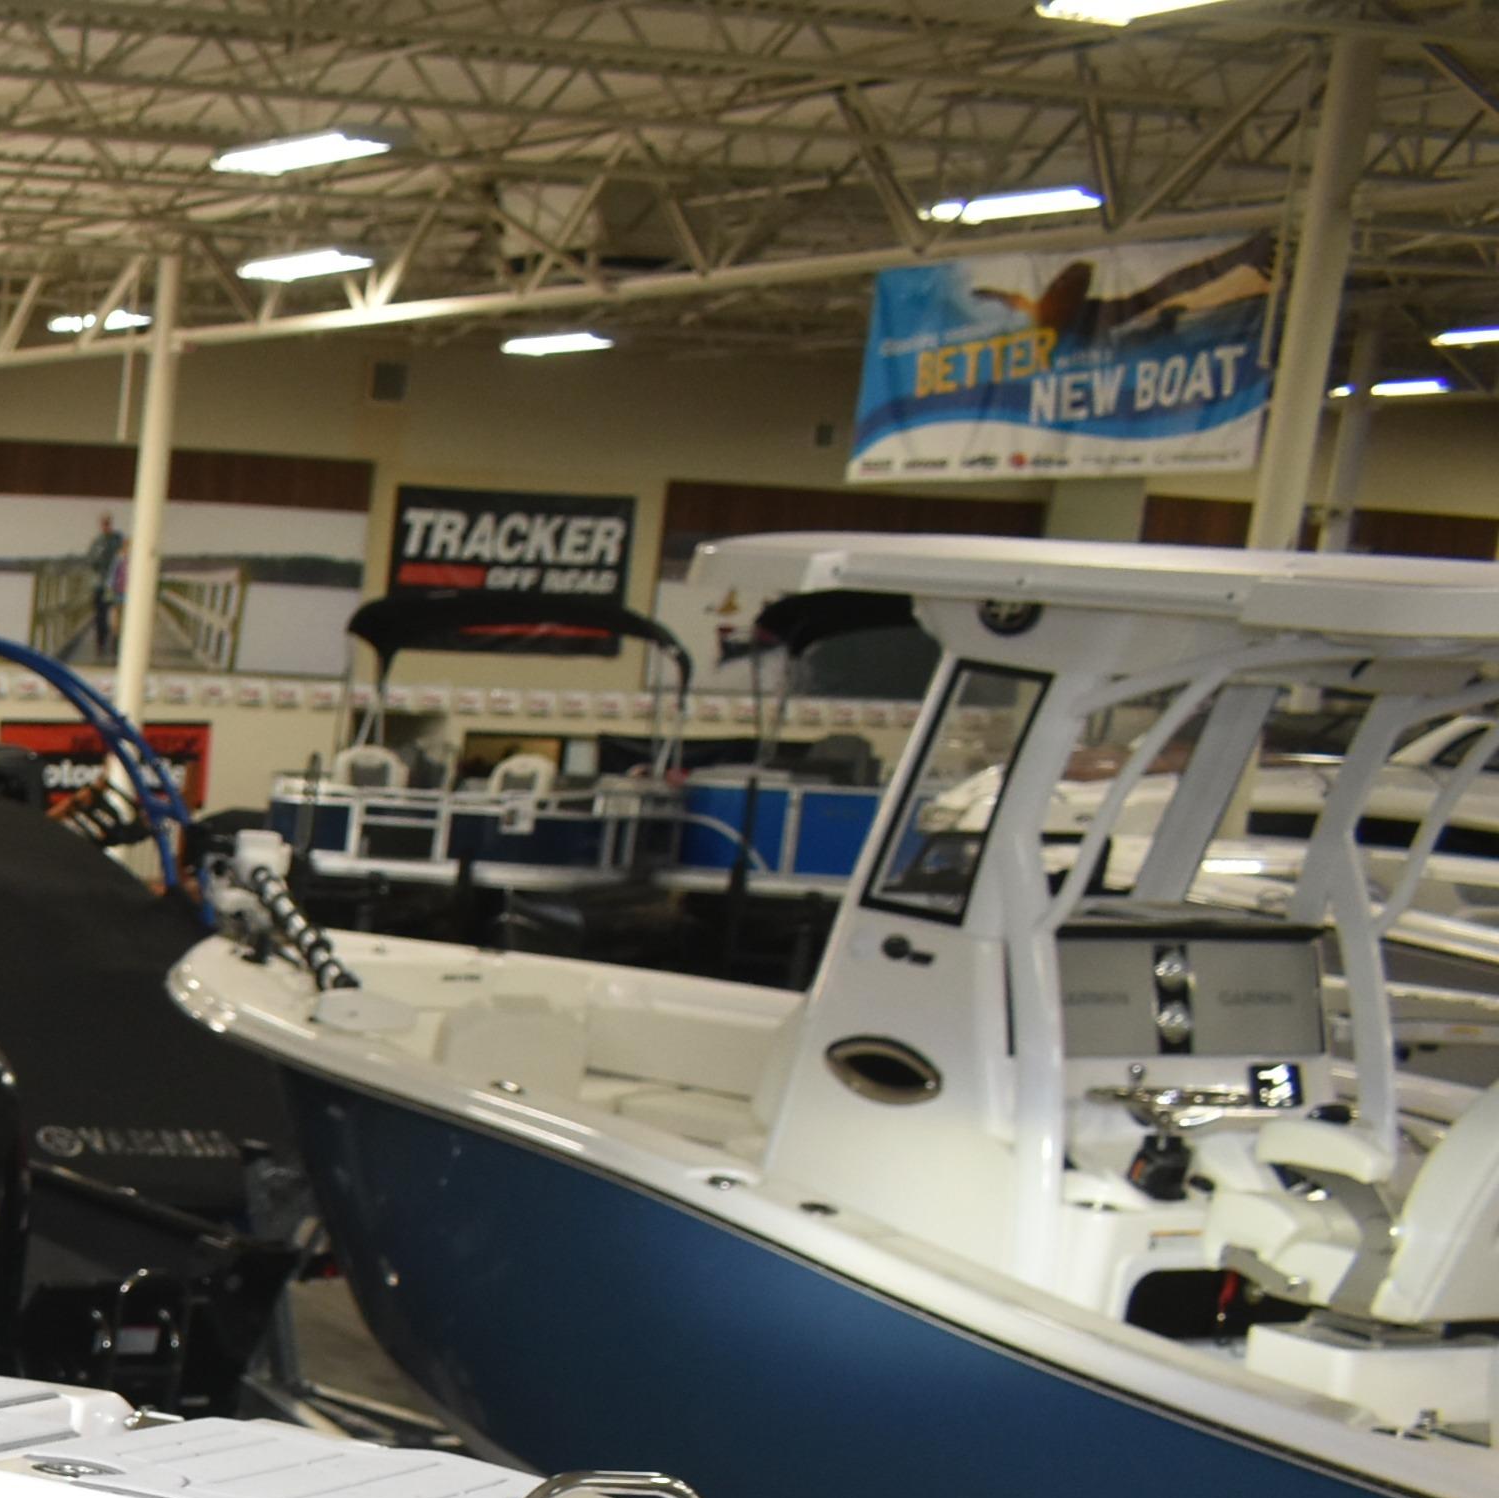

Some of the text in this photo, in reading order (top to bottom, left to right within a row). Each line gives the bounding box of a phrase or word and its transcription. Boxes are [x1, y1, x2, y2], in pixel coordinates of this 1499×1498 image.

[915, 328, 1057, 397] BETTER
[1030, 345, 1246, 425] NEW BOAT
[403, 507, 627, 564] TRACKER
[485, 565, 542, 591] OFF
